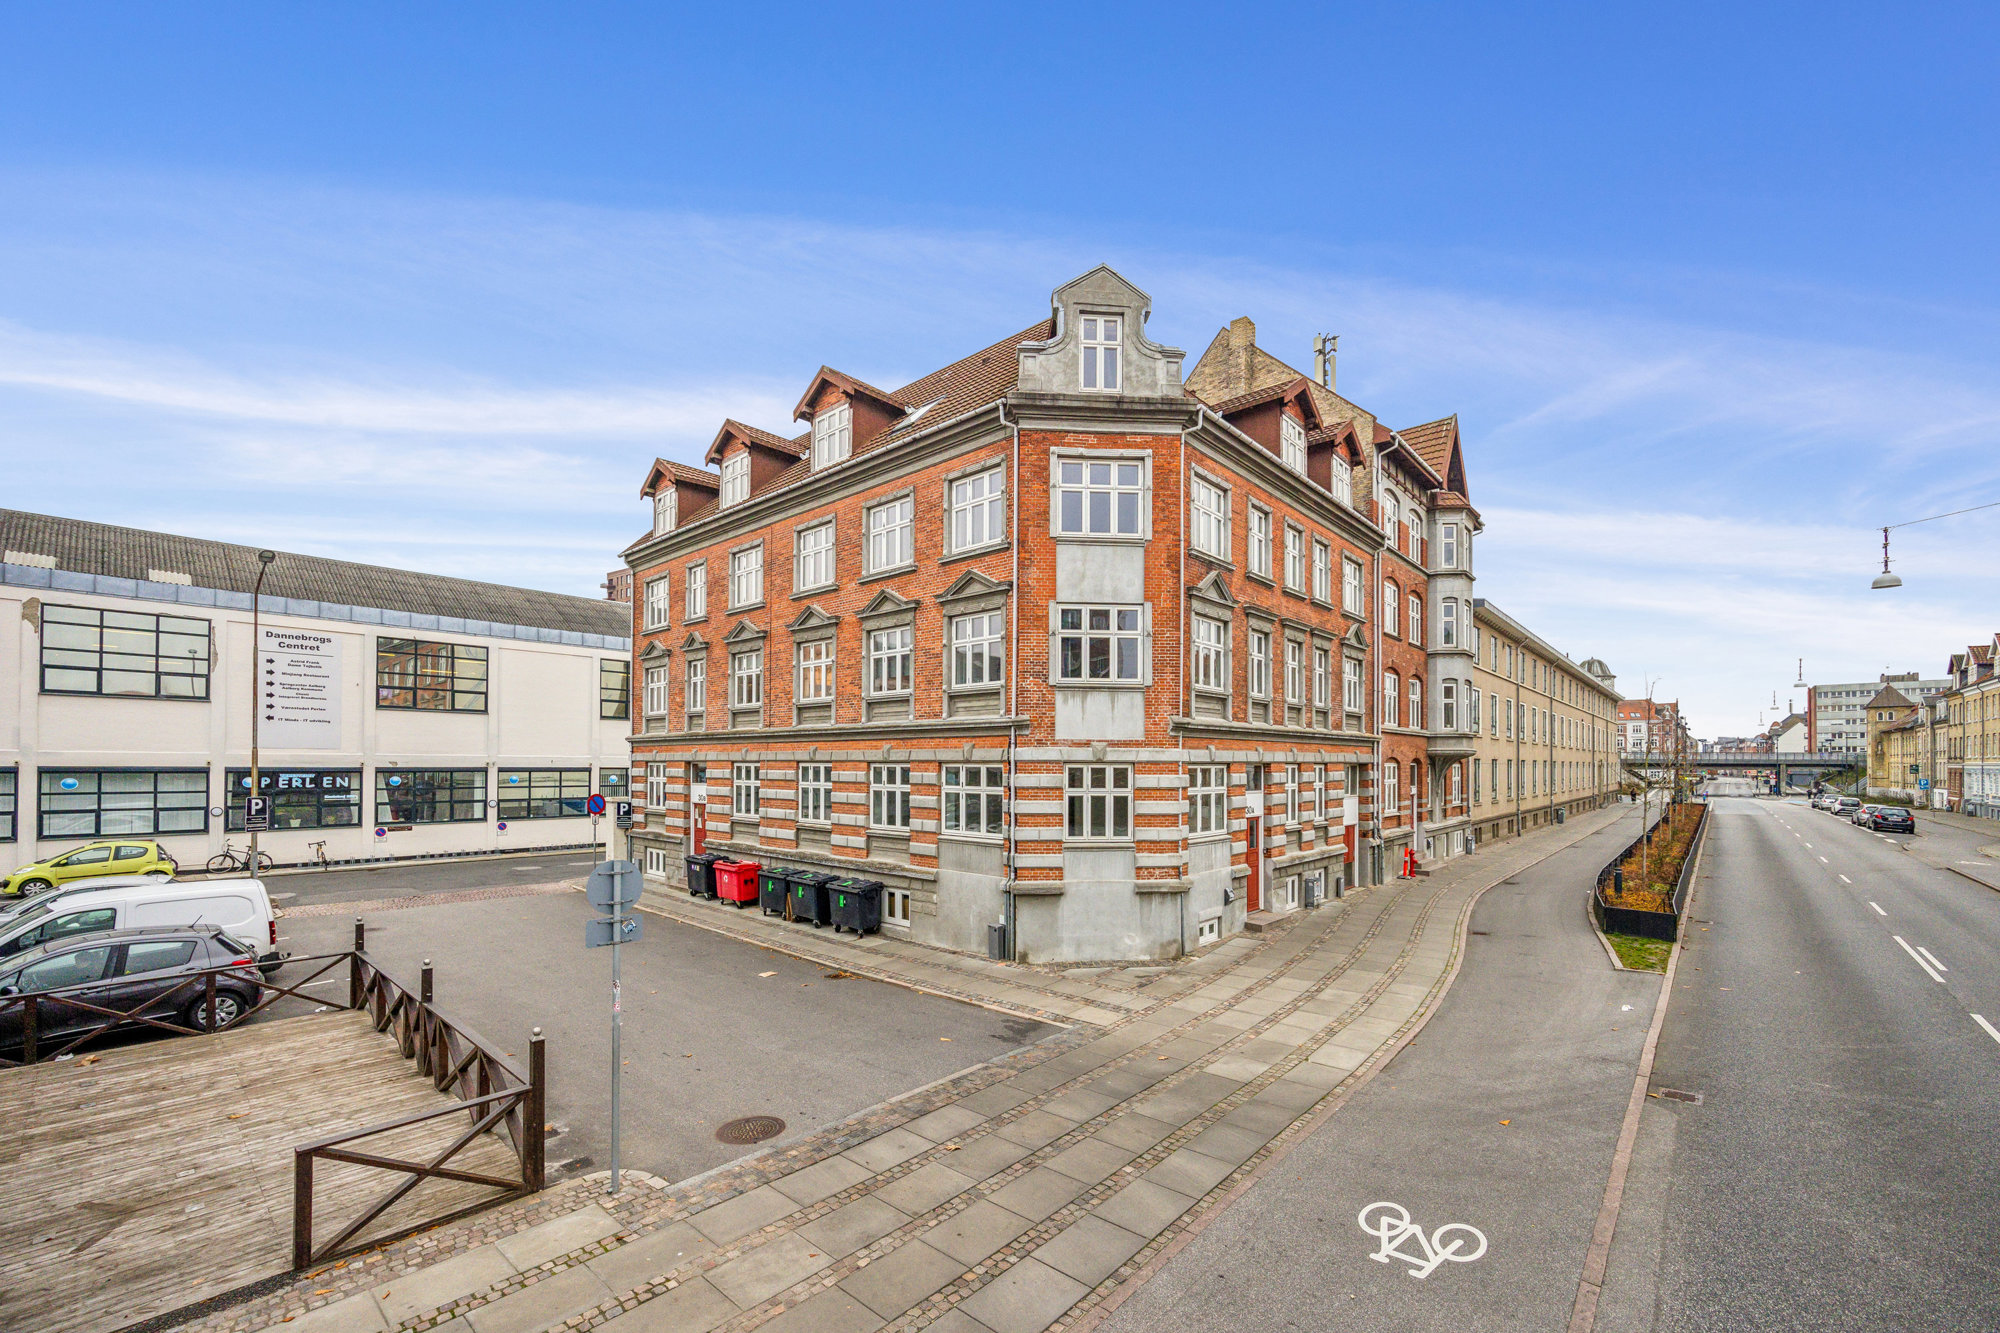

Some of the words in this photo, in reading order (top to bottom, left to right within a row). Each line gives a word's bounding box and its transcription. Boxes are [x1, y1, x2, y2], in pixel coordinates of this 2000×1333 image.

[266, 631, 332, 644] Dannebrogs
[278, 641, 320, 651] Centret
[251, 798, 263, 815] P
[620, 803, 629, 816] P
